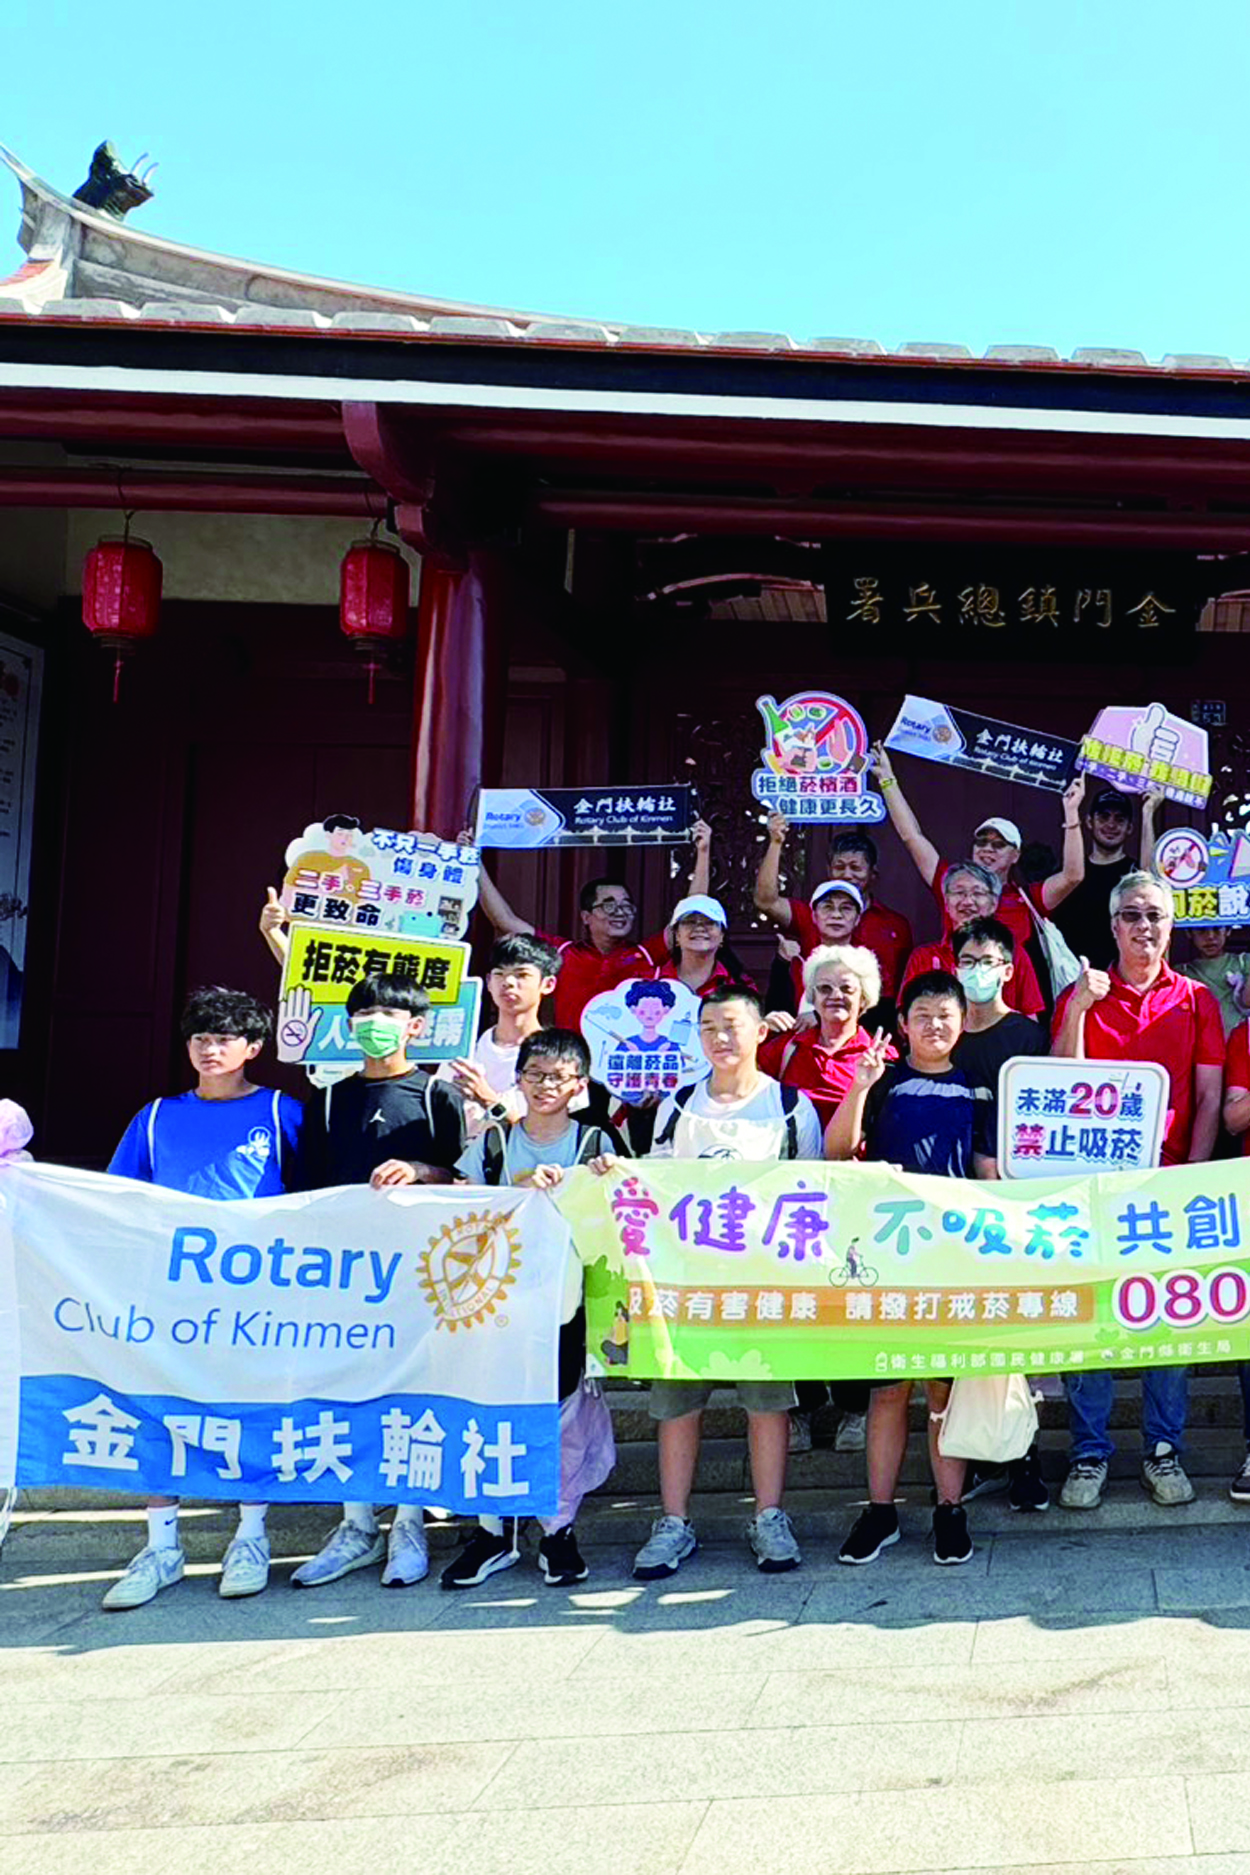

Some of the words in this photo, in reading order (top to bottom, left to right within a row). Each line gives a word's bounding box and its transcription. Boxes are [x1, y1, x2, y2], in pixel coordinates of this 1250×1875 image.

[975, 728, 1064, 763] 金門扶輪社
[758, 776, 858, 793] 拒絕菸檳酒
[573, 796, 676, 814] 金門扶輪社
[606, 815, 628, 824] Club
[629, 815, 640, 824] of
[779, 798, 877, 815] 健康更長久
[372, 828, 481, 865] 不只一手菸
[393, 857, 463, 885] 傷身體
[291, 892, 381, 926] 更致命
[302, 940, 450, 990] 拒菸有態度
[607, 1054, 679, 1070] 遠離菸品
[607, 1072, 678, 1088] 守護青春
[1018, 1082, 1143, 1117] 未滿20歲
[1013, 1123, 1142, 1160] 禁止吸菸
[611, 1177, 830, 1262] 愛健康
[873, 1200, 1090, 1260] 不吸菸
[167, 1226, 403, 1303] Rotary
[54, 1296, 154, 1343] Club
[173, 1307, 220, 1345] of
[232, 1310, 395, 1349] Kinmen
[845, 1289, 1079, 1322] 請撥打戒菸專線
[891, 1350, 1084, 1370] 衛生福利部國民健康署
[1120, 1339, 1231, 1360] 金門縣衛生局
[61, 1393, 530, 1499] 金門扶輪社
